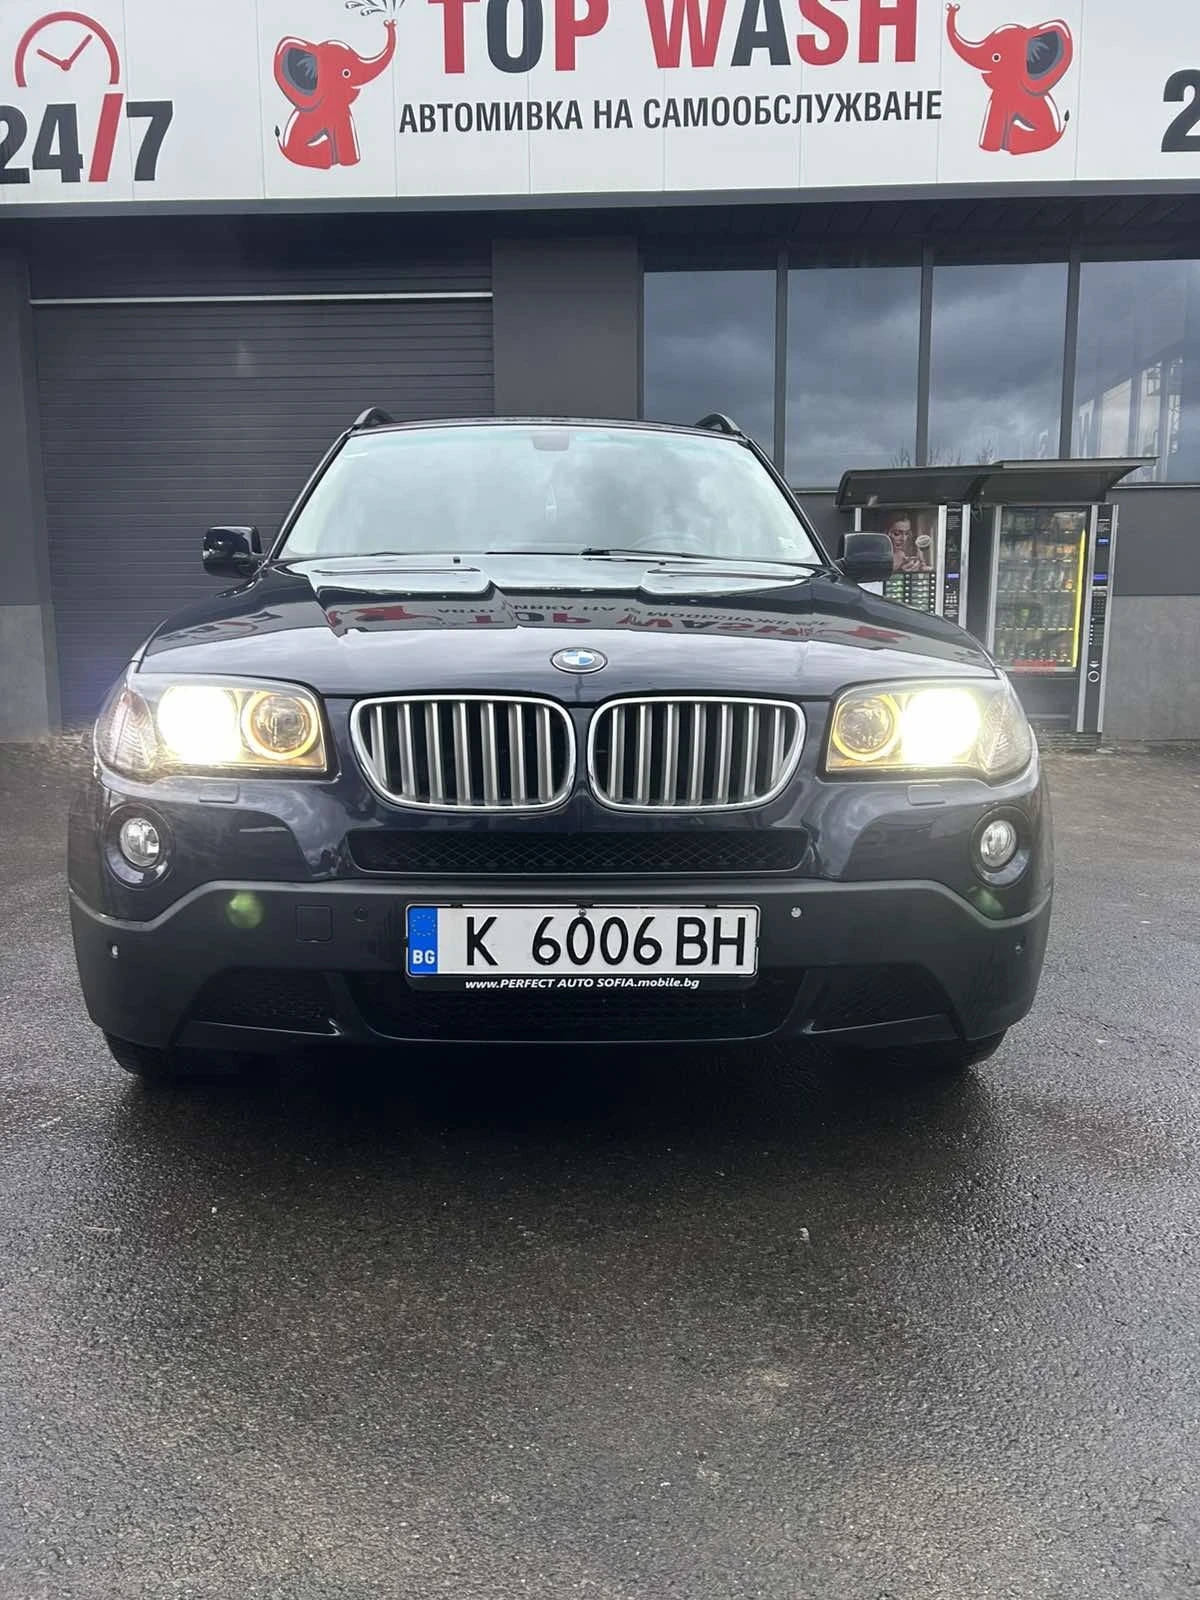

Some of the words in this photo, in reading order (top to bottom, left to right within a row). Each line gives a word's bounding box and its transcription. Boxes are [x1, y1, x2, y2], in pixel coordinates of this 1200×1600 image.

[427, 0, 609, 74] TOP
[646, 0, 916, 69] WASH
[399, 100, 584, 133] АВТОМИВКА
[594, 98, 633, 130] НА
[643, 90, 942, 129] САМООБСЛУЖВАНЕ
[0, 93, 174, 184] 24/7
[412, 950, 436, 965] BG
[466, 916, 499, 966] K
[532, 916, 663, 966] 6006
[675, 916, 747, 966] BH
[465, 978, 555, 989] www.PERFECT
[557, 978, 594, 989] AUTO
[596, 978, 700, 990] SOFIA.mobile.bg
